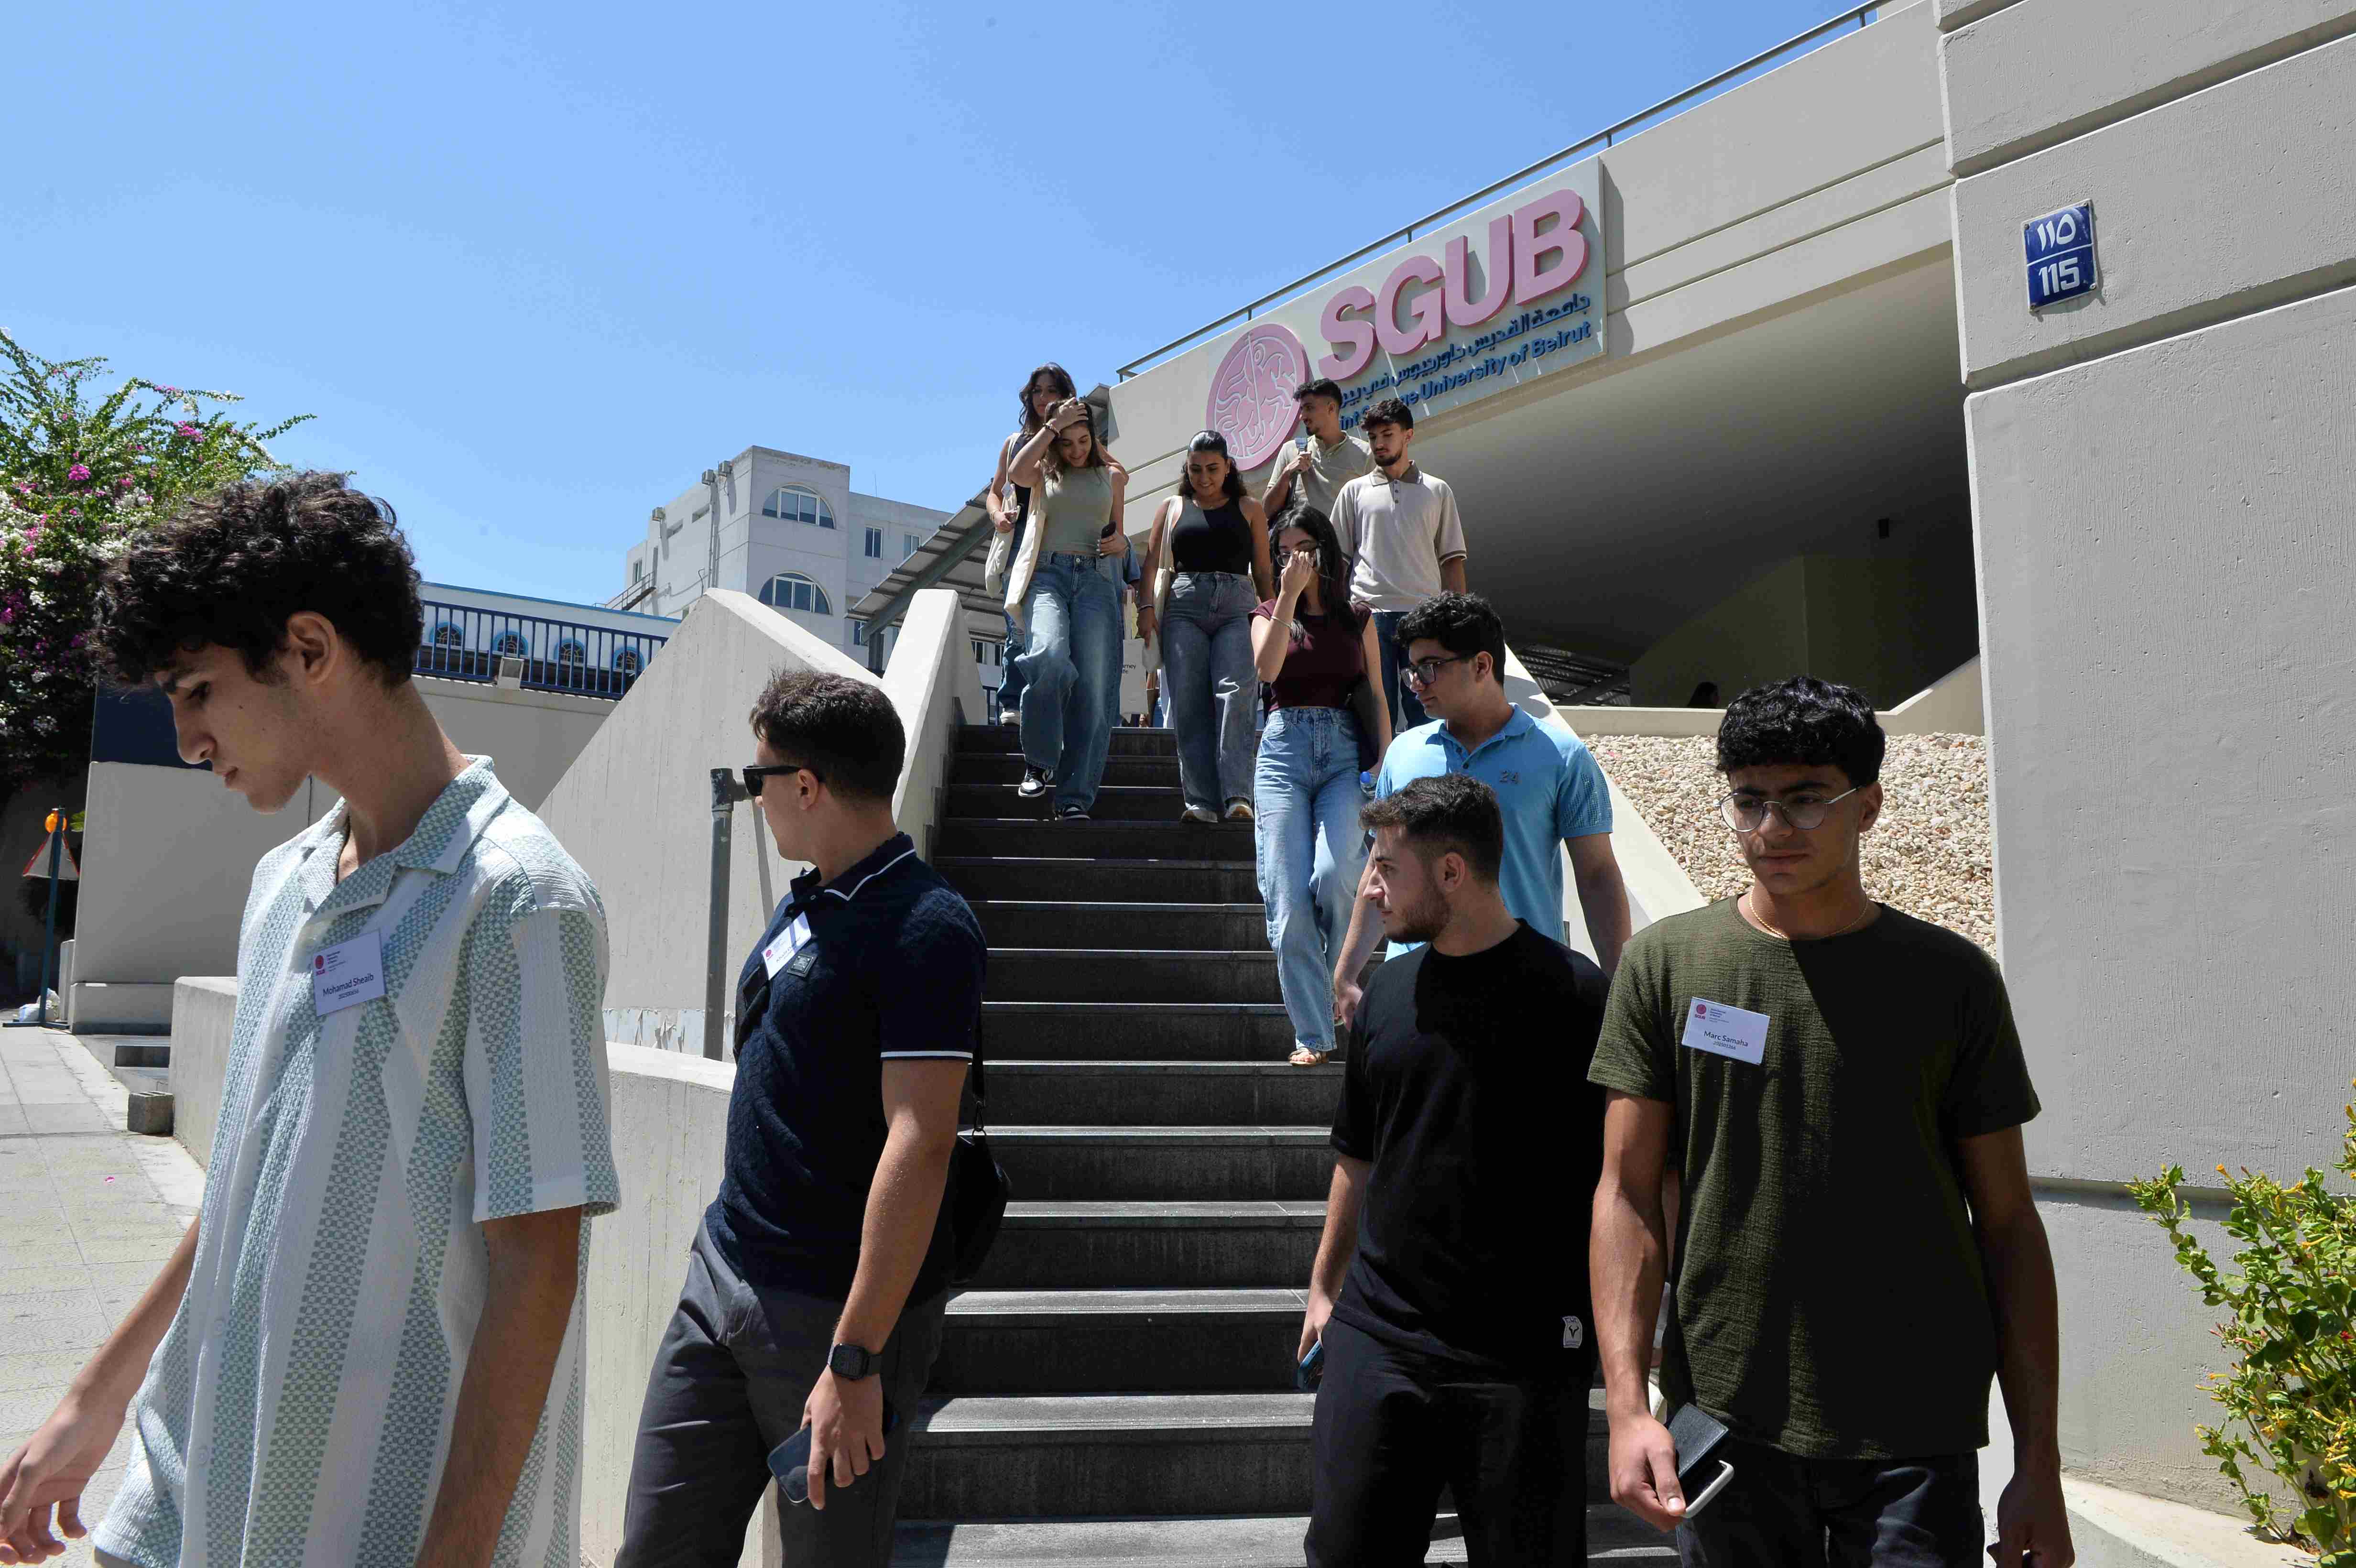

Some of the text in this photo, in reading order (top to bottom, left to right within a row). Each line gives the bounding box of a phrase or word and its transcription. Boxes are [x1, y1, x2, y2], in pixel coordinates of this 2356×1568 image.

[2037, 214, 2076, 251] ١١٥
[1319, 189, 1589, 381] SGUB
[2039, 257, 2080, 296] 115
[1531, 293, 1591, 329] جامعة
[1468, 313, 1529, 357] القديس
[1341, 321, 1591, 430] int University of Beirut
[1389, 343, 1466, 387] جاورجيوس
[1339, 386, 1362, 410] بير
[1363, 372, 1390, 400] في
[323, 979, 352, 996] Mohamad
[353, 973, 374, 987] Sheaib
[1704, 1030, 1748, 1047] Marc Samaha
